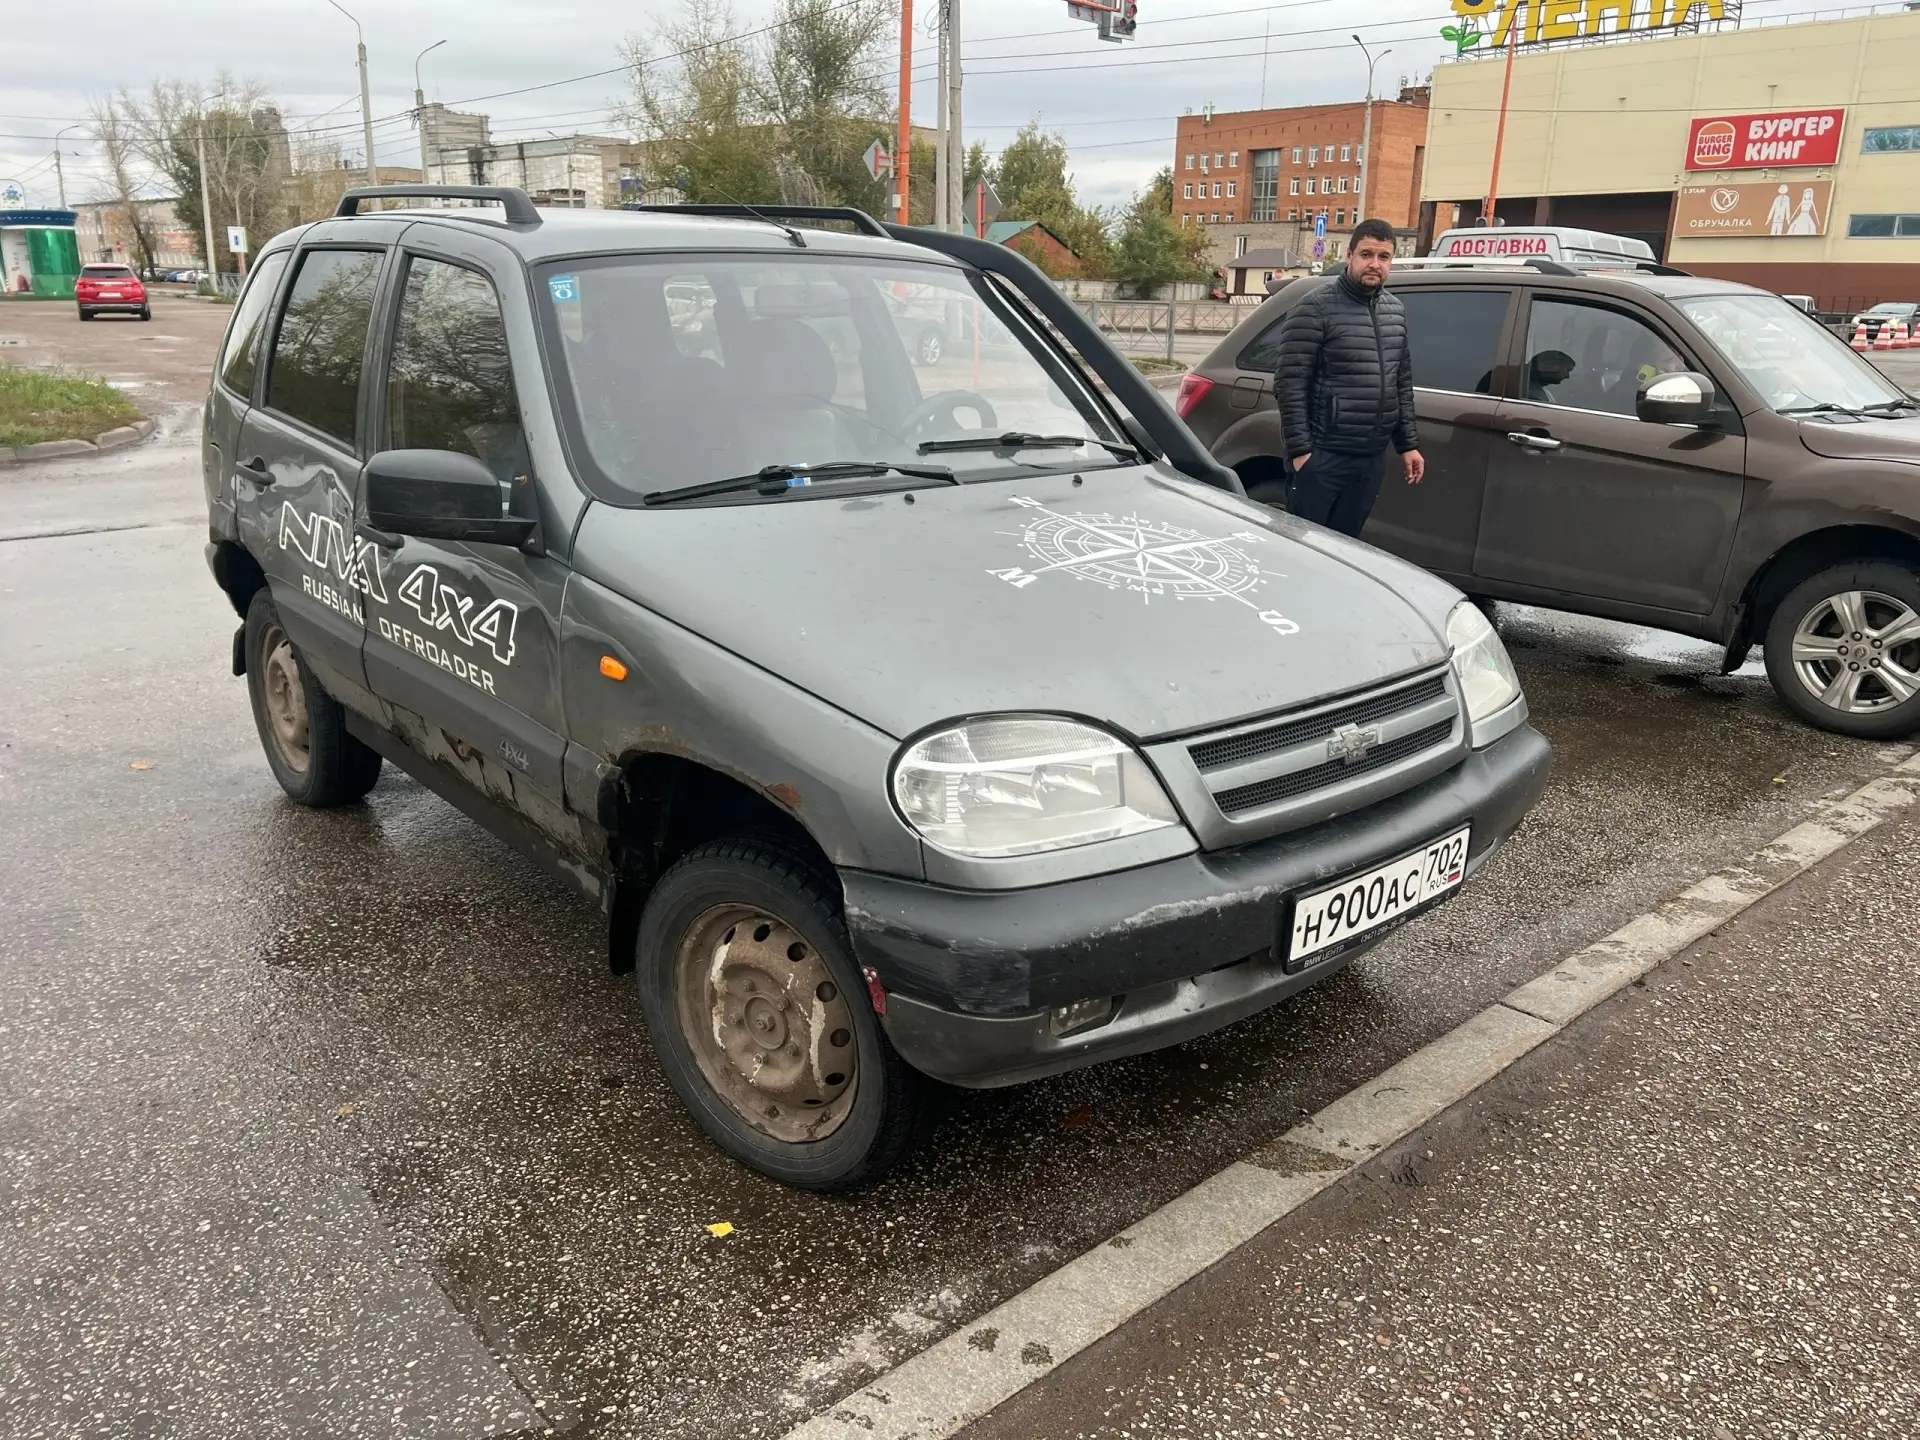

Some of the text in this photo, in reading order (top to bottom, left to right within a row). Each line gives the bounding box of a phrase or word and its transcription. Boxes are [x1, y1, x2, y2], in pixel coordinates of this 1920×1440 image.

[1749, 116, 1834, 139] БУРГЕР
[1697, 144, 1731, 156] KING
[1698, 134, 1732, 145] BURGER
[1745, 140, 1806, 162] КИНГ
[1690, 218, 1752, 228] ОБРУЧАЛКА
[1449, 238, 1547, 257] ДОСТАВКА
[279, 500, 388, 604] NIVA
[1258, 609, 1300, 635] S
[302, 574, 497, 696] RUSSIAN OFFROADER
[1427, 837, 1463, 883] 702
[1429, 873, 1448, 892] RUS
